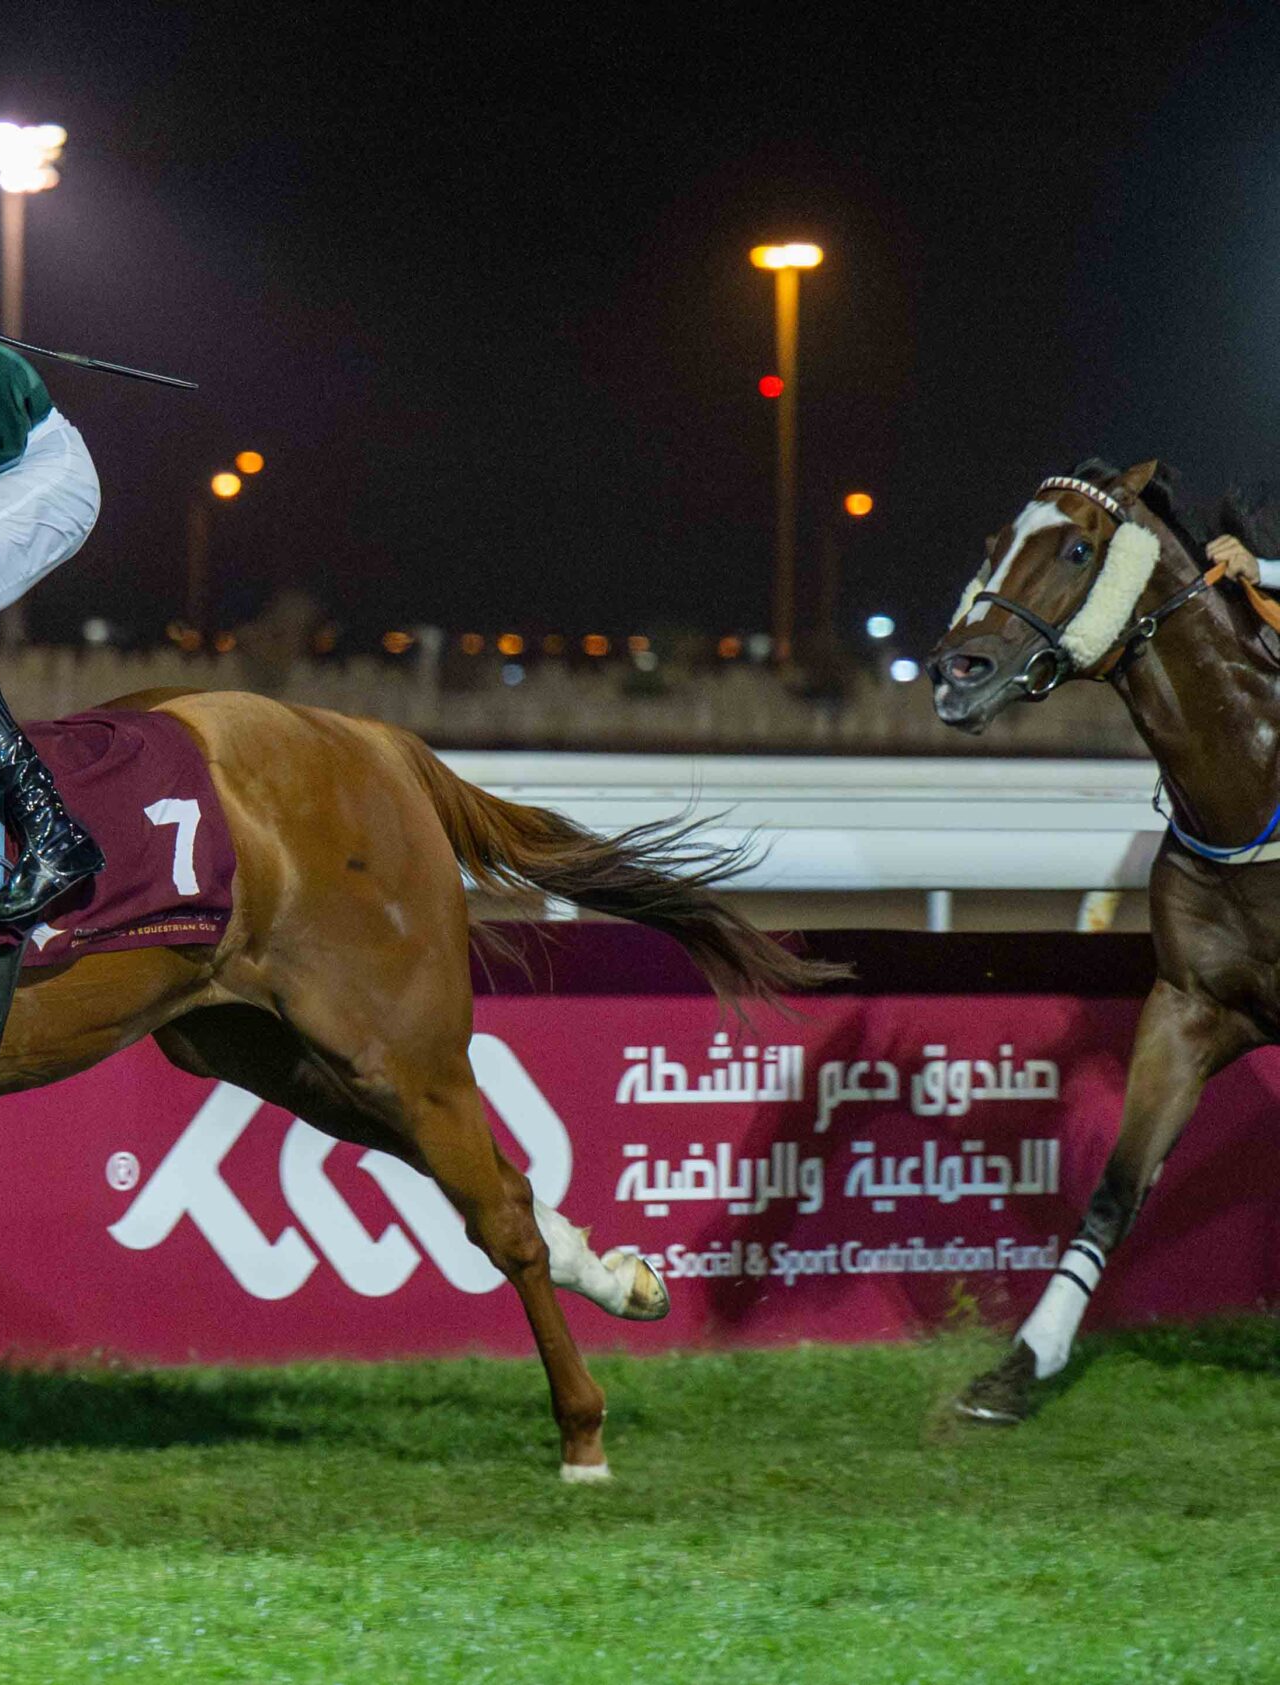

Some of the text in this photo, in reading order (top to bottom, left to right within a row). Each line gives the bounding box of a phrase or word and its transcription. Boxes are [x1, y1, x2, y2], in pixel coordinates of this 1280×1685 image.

[144, 799, 201, 895] 7
[137, 924, 196, 935] EQUESTRIAN
[616, 1033, 1059, 1132] صندوق دعم الأنشطة
[616, 1139, 1060, 1217] الاجتماعية والرياضية
[667, 1241, 742, 1278] Social
[745, 1243, 767, 1276] &
[771, 1243, 839, 1286] Sport
[841, 1237, 994, 1274] Contribution
[996, 1236, 1059, 1271] Fund
